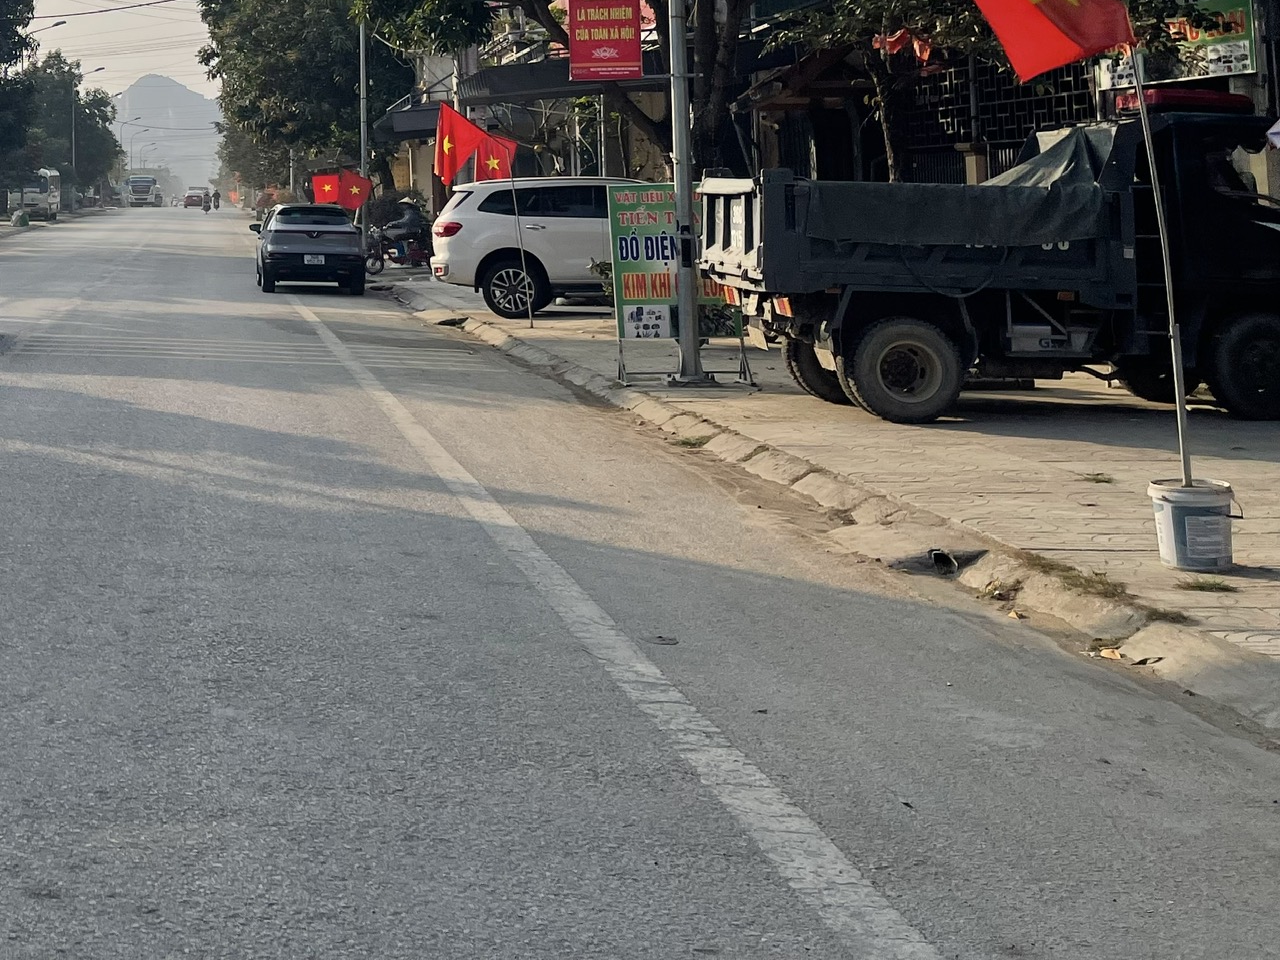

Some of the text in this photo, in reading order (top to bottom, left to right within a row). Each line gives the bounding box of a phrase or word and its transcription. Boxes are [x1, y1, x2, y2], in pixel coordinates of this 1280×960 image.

[577, 5, 633, 22] LÀ TRÁCH NHIỆM
[575, 25, 589, 41] CỦA
[591, 26, 609, 41] TOÀN
[609, 25, 620, 40] XÃ
[618, 227, 640, 261] ĐỒ
[623, 273, 647, 299] KIM
[650, 267, 672, 298] KHÍ
